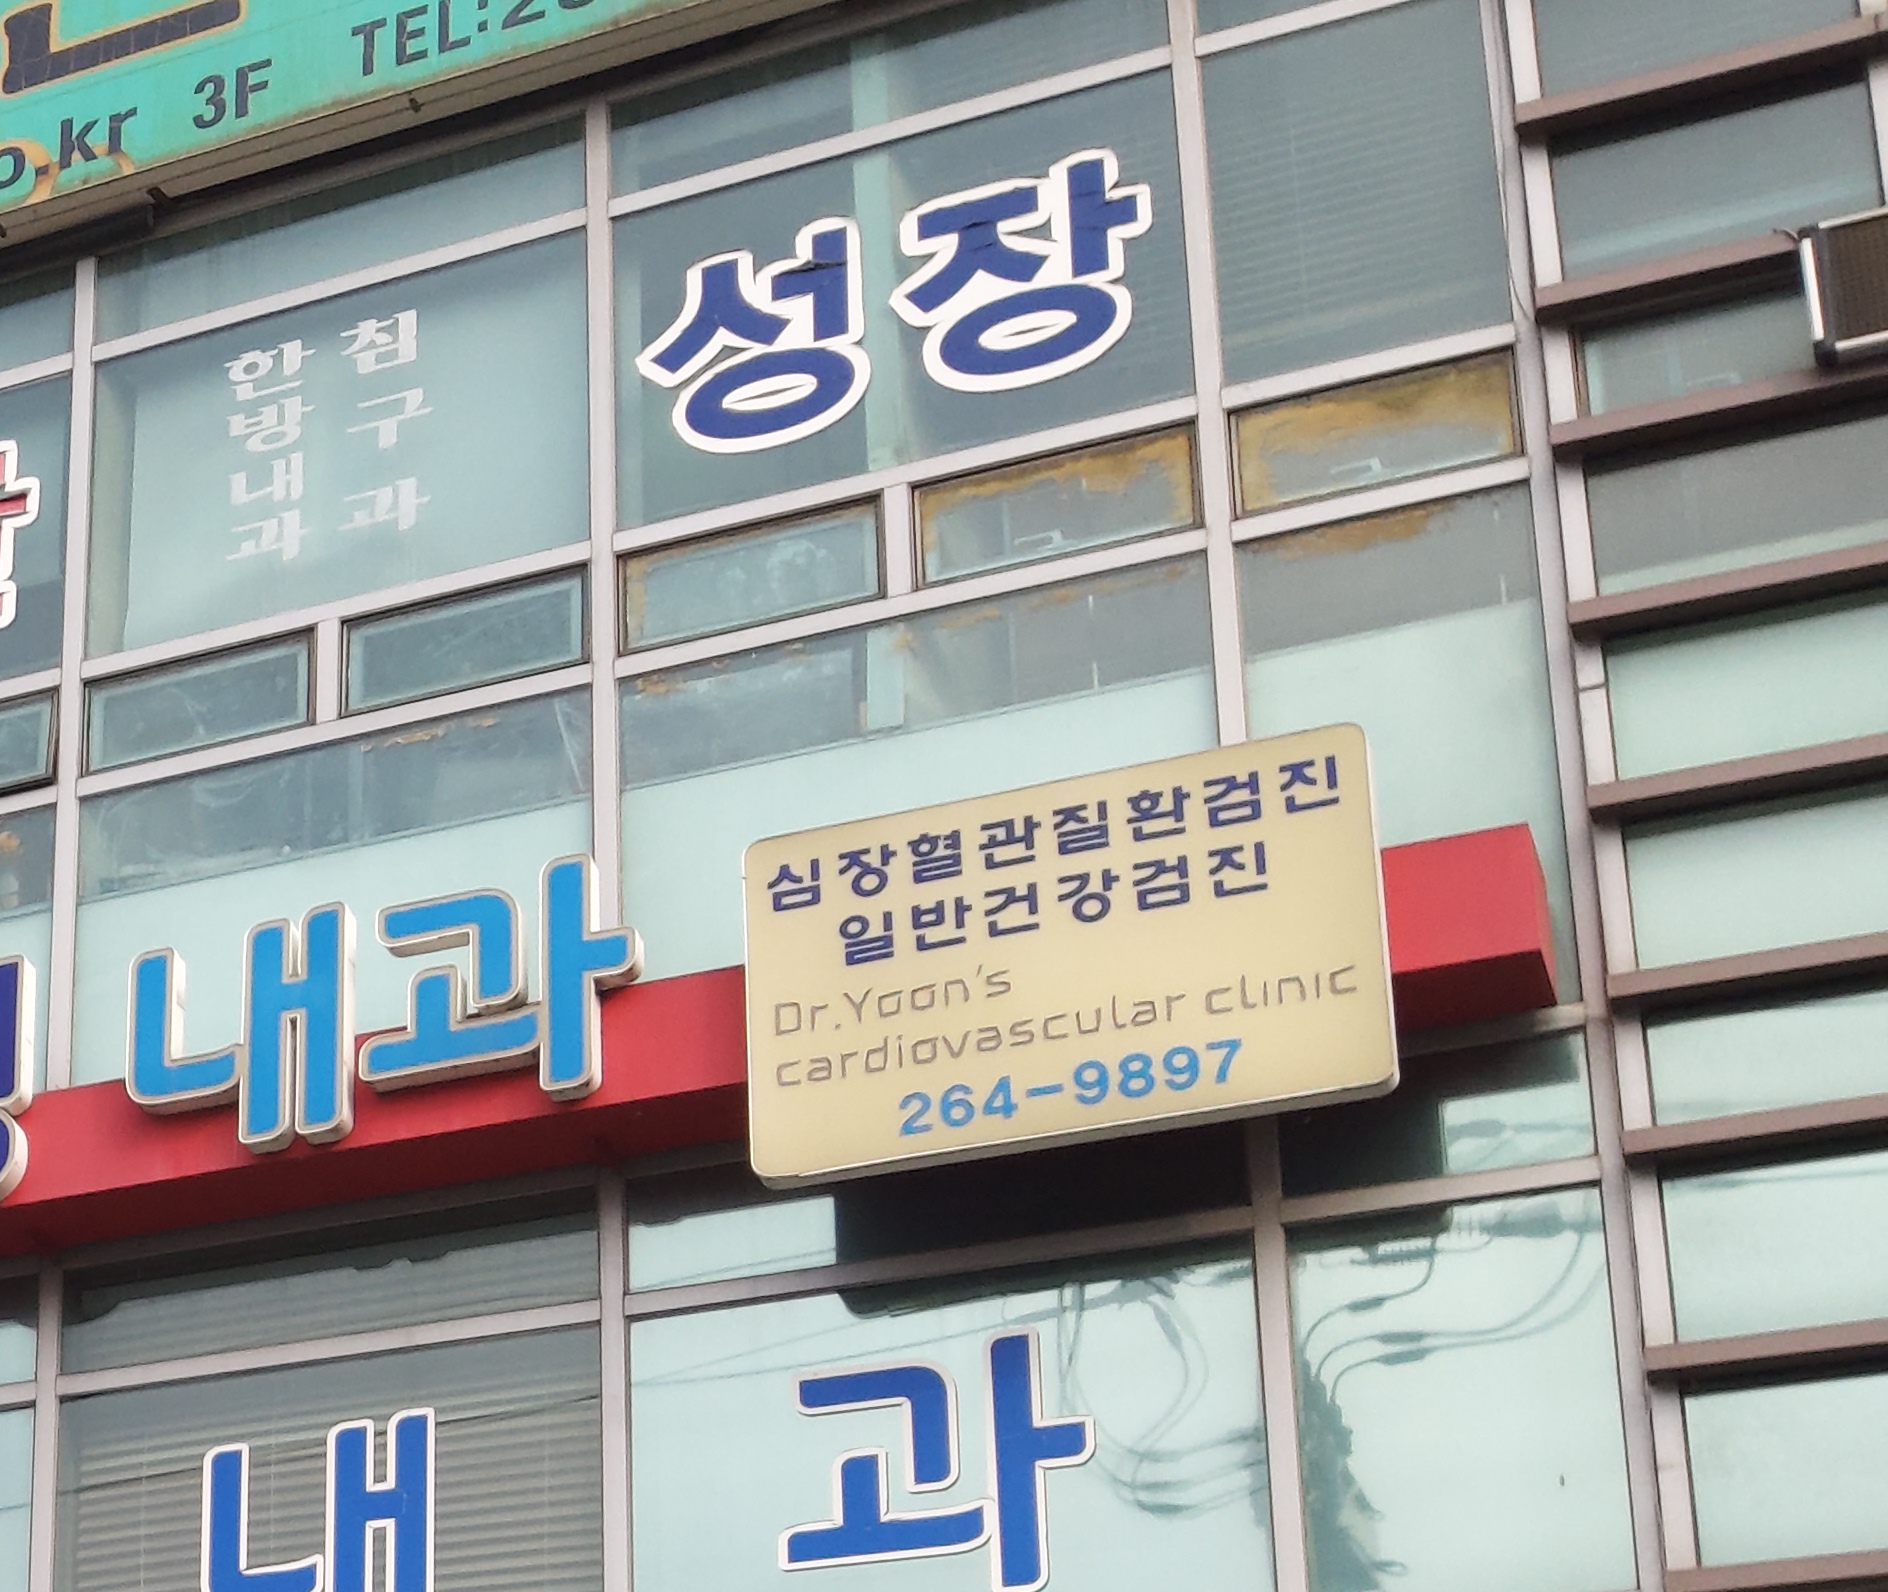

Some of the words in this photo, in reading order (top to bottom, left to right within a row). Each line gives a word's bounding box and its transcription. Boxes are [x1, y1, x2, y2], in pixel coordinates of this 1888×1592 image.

[191, 58, 273, 131] 3F
[634, 147, 1154, 455] 성장
[767, 754, 1344, 913] 심장혈관질환검진
[838, 840, 1271, 968] 일반건강검진
[126, 850, 644, 1154] 내과
[773, 964, 1013, 1038] Dr.Yoon's
[776, 988, 1185, 1088] cardiovascular
[1204, 962, 1358, 1017] clinic
[897, 1037, 1244, 1139] 264-9897
